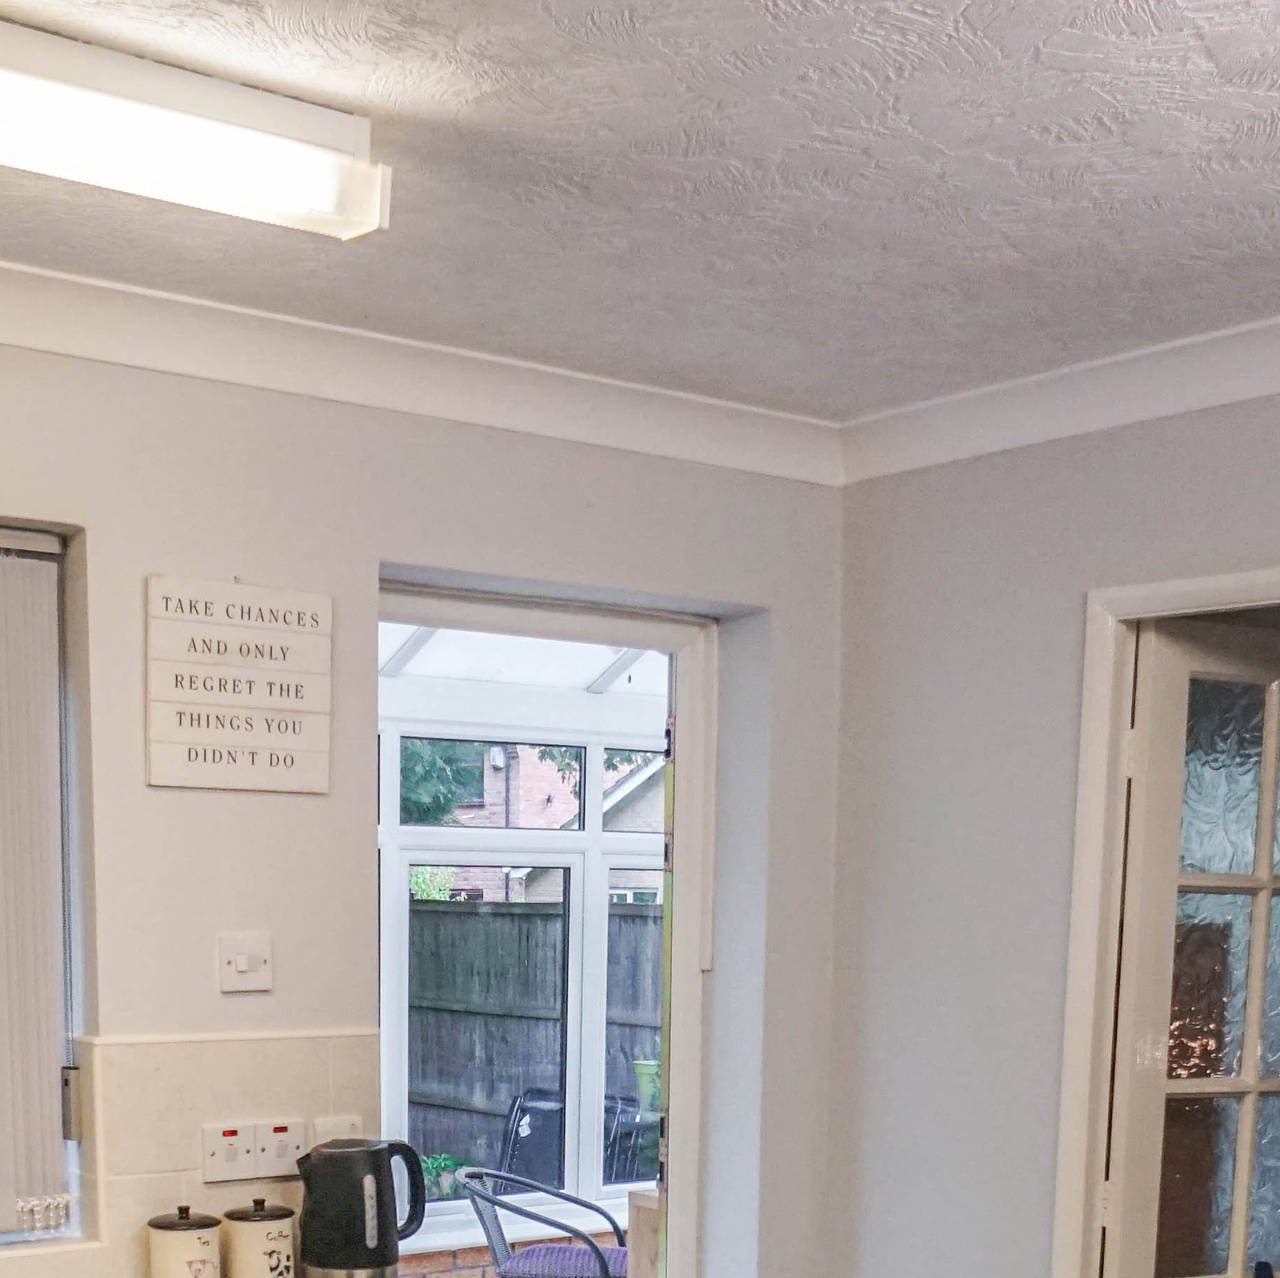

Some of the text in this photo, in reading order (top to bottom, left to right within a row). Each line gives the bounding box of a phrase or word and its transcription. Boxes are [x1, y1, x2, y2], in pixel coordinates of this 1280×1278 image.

[162, 596, 320, 628] TAKE CHANCES
[187, 637, 289, 661] AND ONLY
[174, 673, 305, 699] REGRET THE
[176, 712, 303, 735] THINGS YOU
[187, 747, 295, 768] DIDN'T DO
